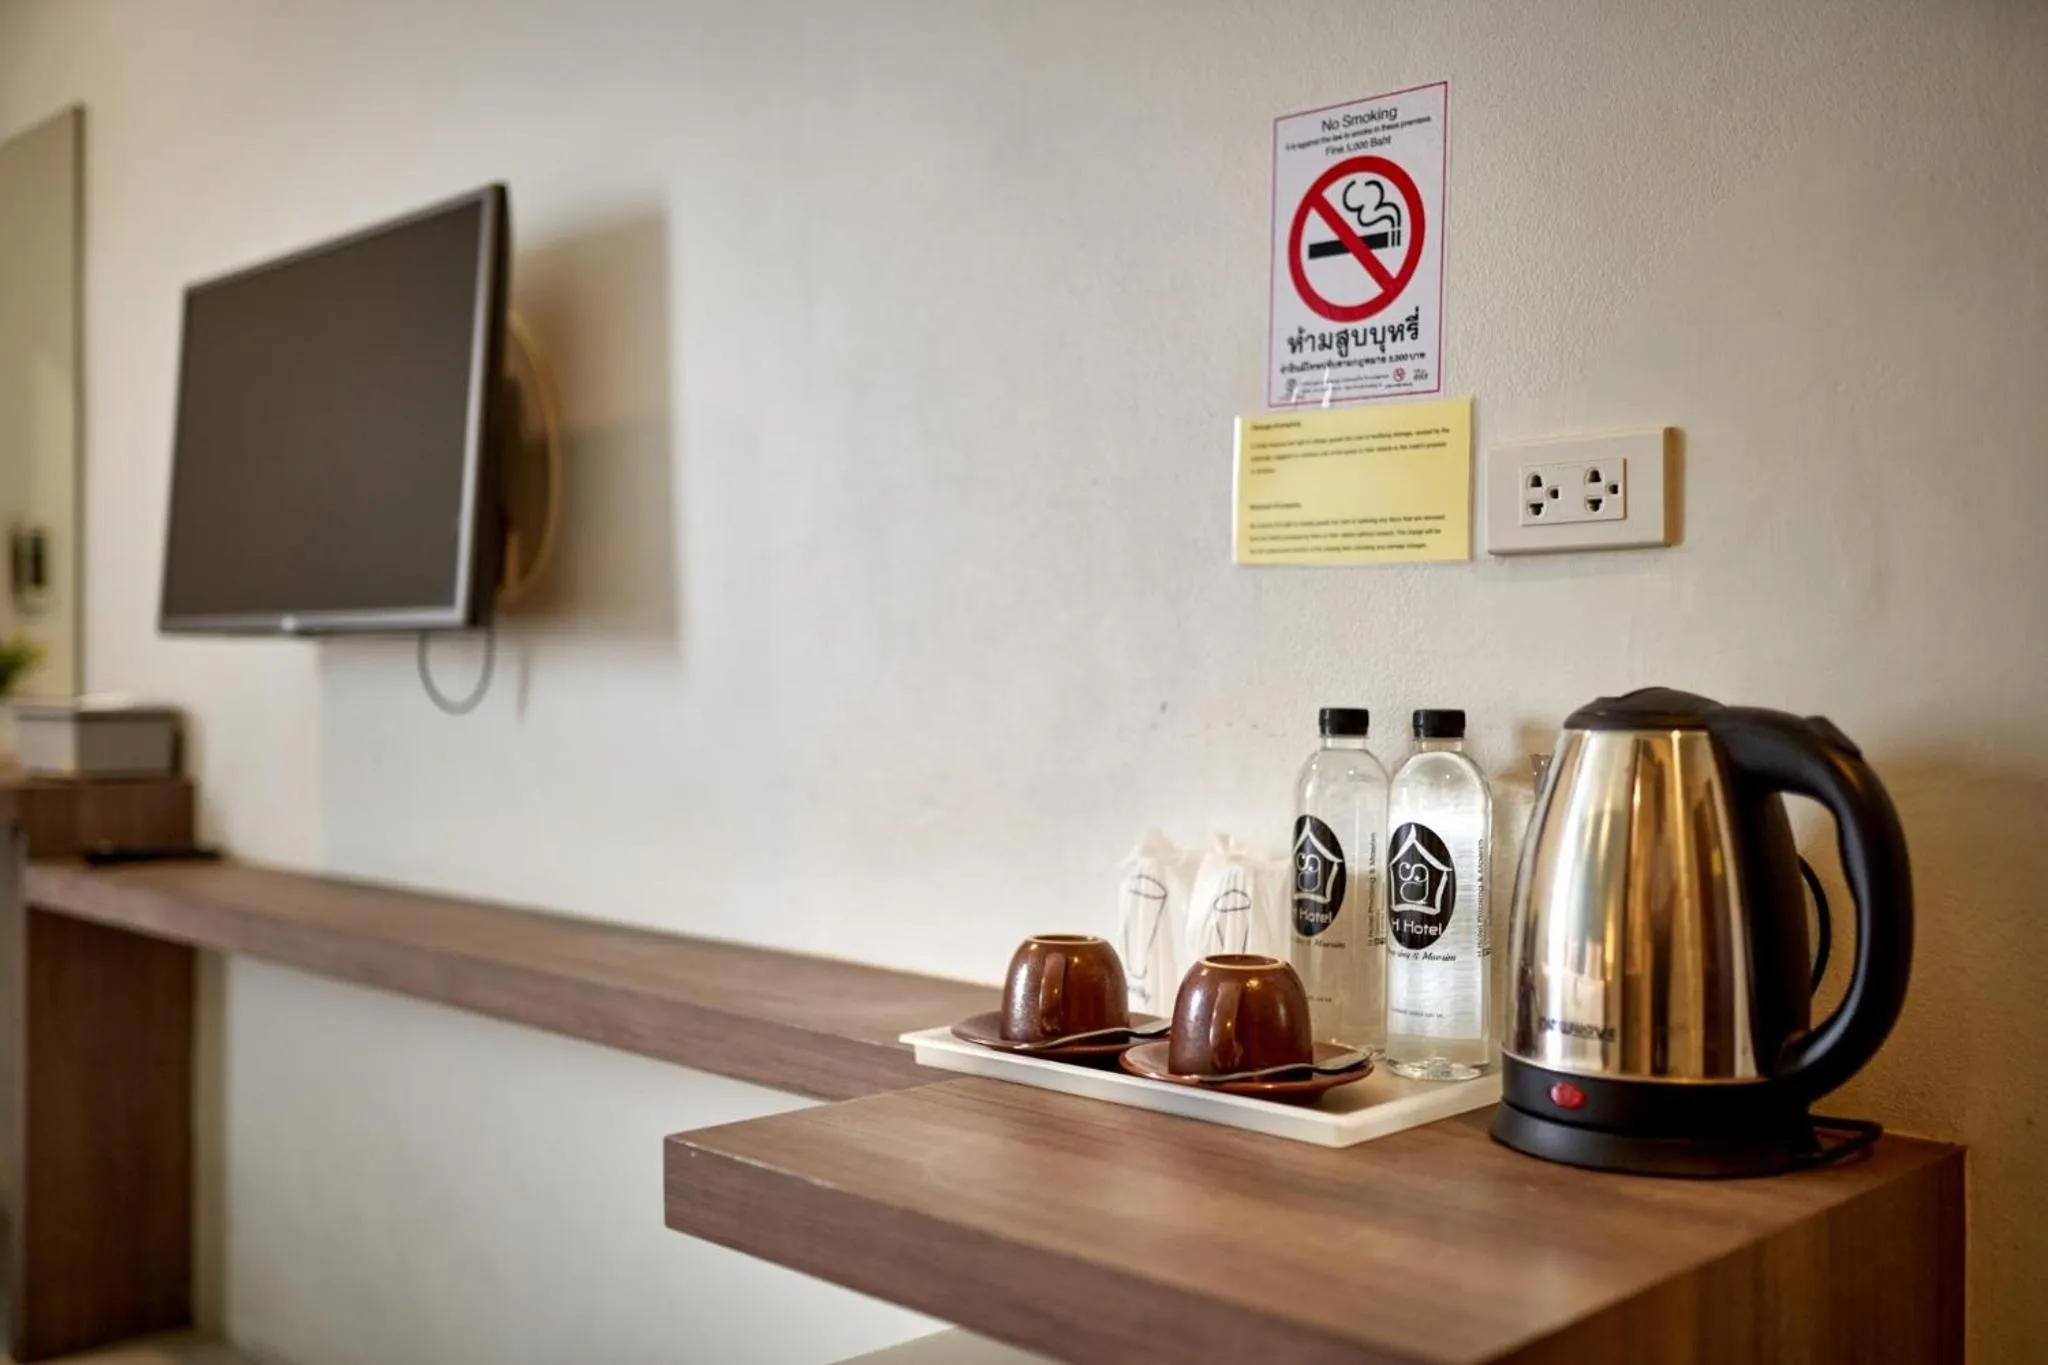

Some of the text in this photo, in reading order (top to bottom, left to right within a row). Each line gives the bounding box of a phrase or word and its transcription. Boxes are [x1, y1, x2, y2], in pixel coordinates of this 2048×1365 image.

[1321, 107, 1398, 132] No Smoking
[1325, 146, 1344, 156] Fine
[1370, 135, 1392, 148] Baht
[1287, 306, 1420, 357] ห้ามสูบบุหรี่
[1300, 908, 1332, 924] Hotel
[1403, 919, 1443, 936] Hotel
